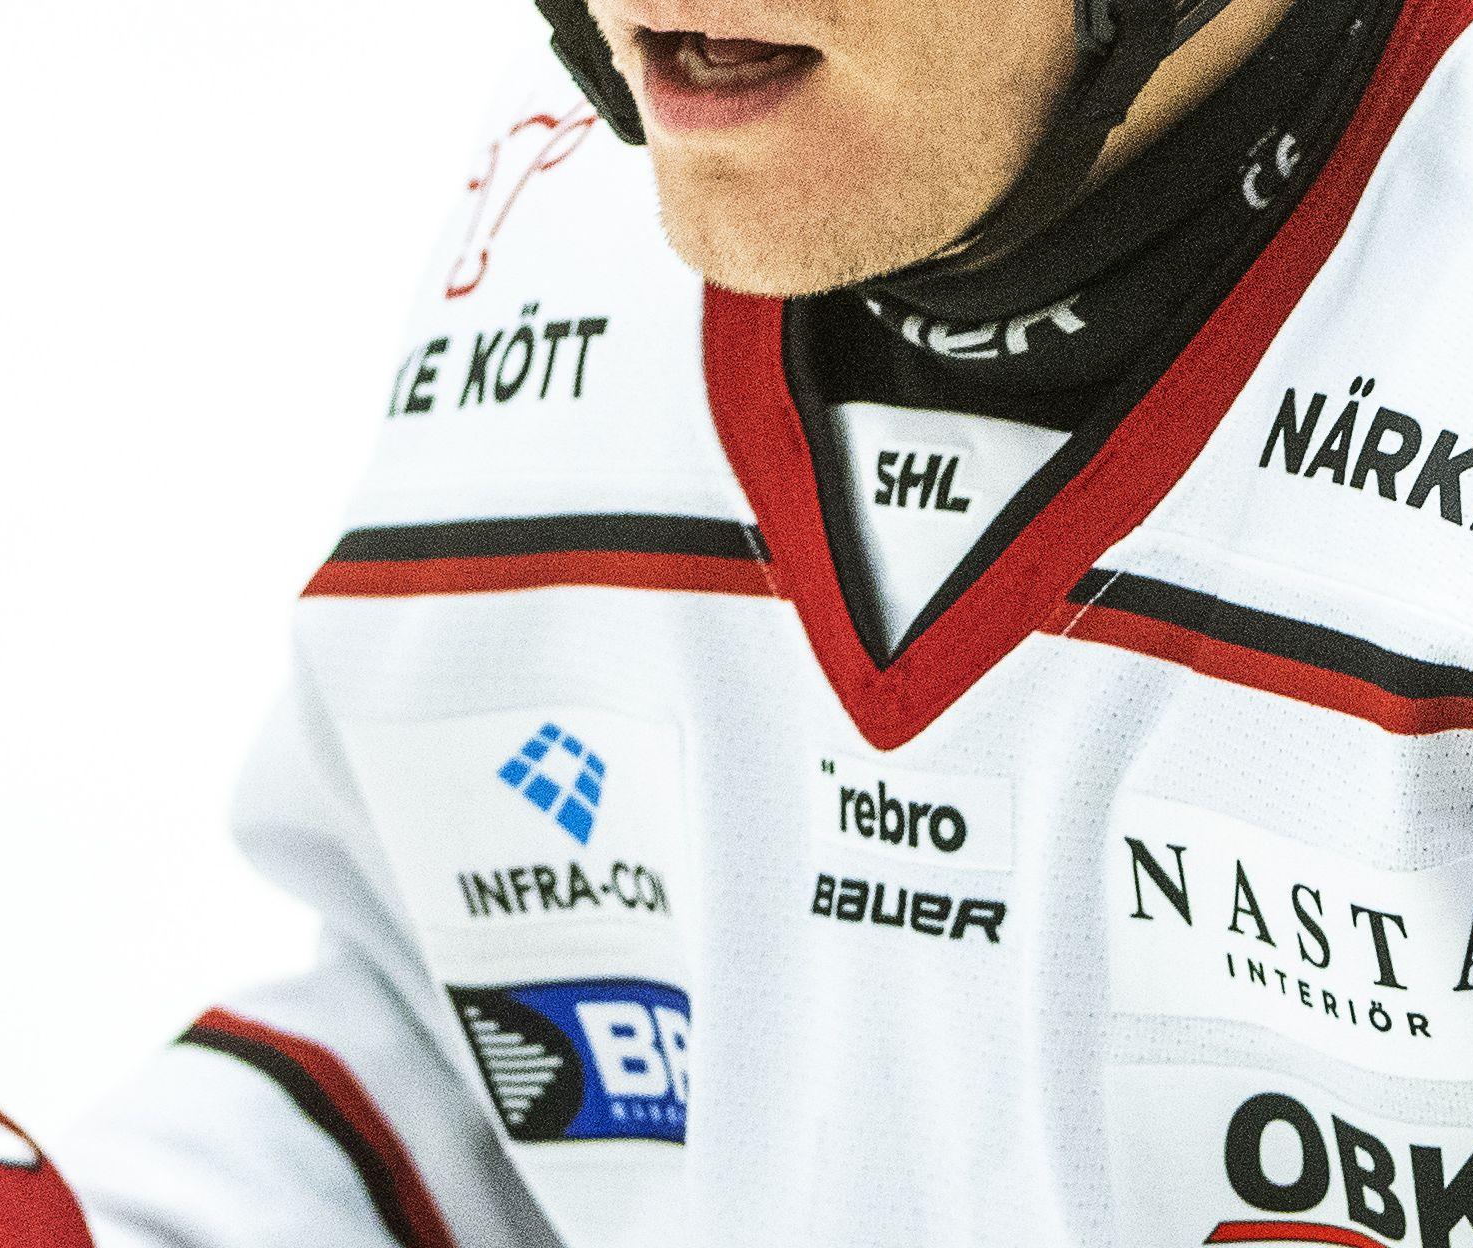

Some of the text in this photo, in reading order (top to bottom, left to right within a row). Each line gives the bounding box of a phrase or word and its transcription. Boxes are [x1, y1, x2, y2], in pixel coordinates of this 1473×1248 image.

[457, 299, 609, 409] KÖTT
[874, 450, 971, 514] SHL
[811, 872, 1007, 944] BAUER
[1225, 952, 1433, 1039] INTERIÖR
